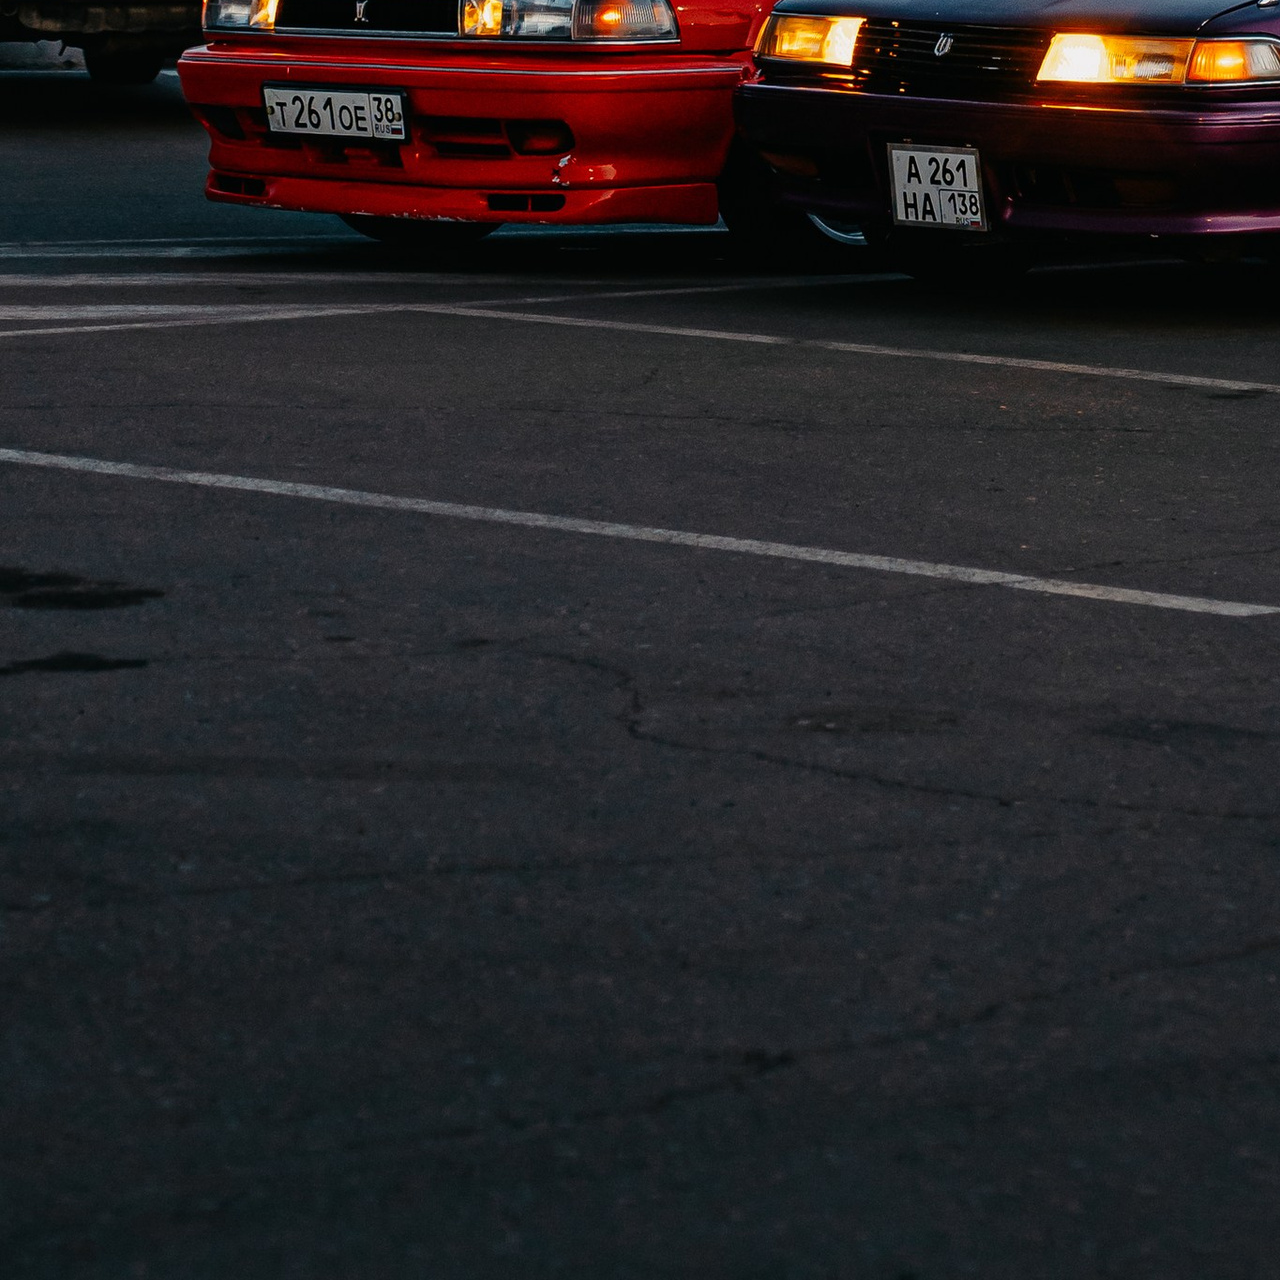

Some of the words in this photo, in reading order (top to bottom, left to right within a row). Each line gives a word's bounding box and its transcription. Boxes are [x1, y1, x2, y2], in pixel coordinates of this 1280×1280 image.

[372, 96, 395, 123] 38
[374, 123, 391, 134] RUS
[947, 192, 979, 216] 138
